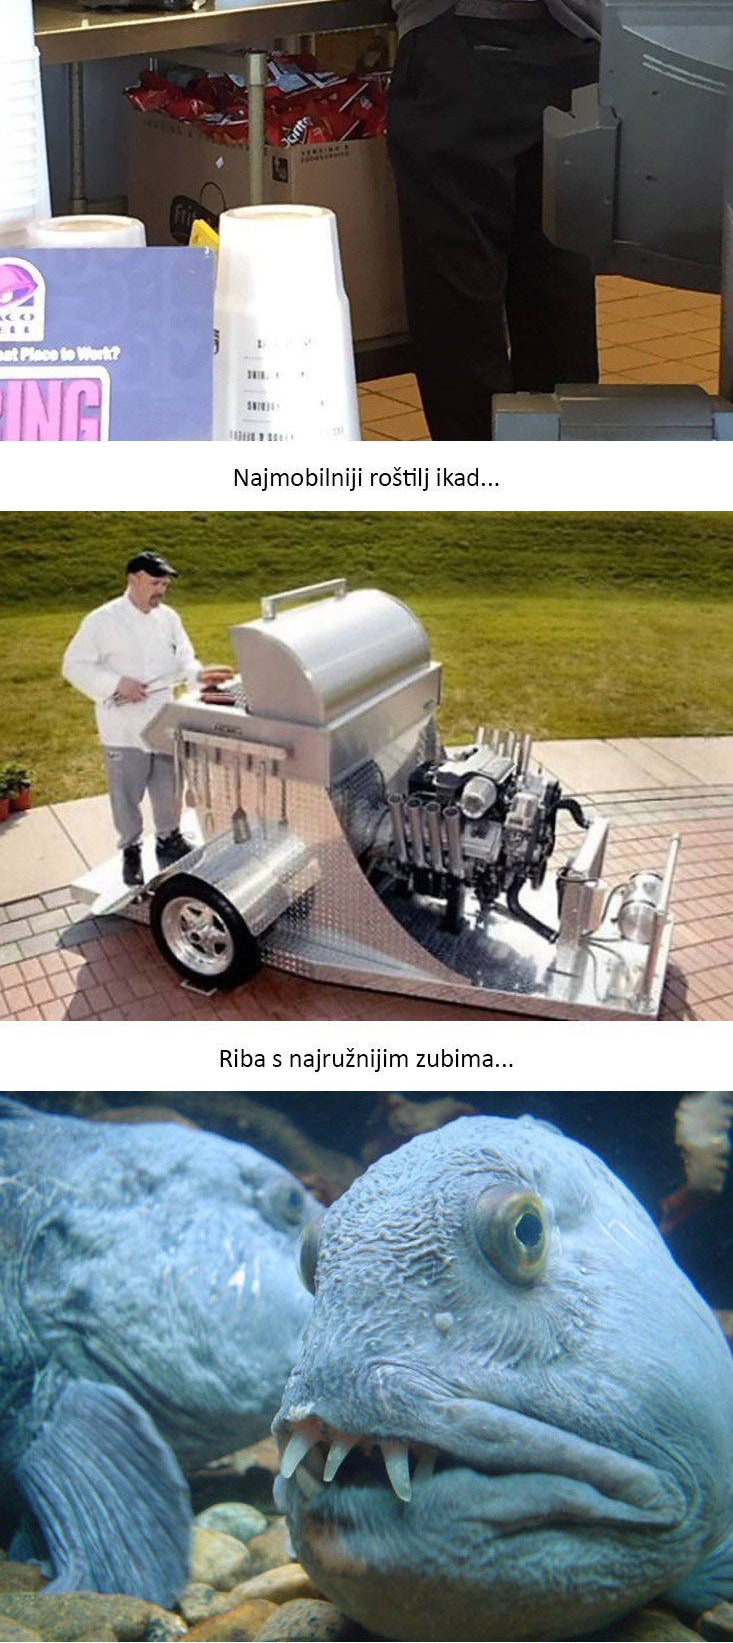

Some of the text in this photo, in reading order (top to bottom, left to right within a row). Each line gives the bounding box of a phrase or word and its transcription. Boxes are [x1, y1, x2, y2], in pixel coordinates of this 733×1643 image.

[20, 345, 59, 363] Place
[60, 346, 76, 362] to
[76, 345, 121, 362] Work?
[0, 379, 101, 441] ING
